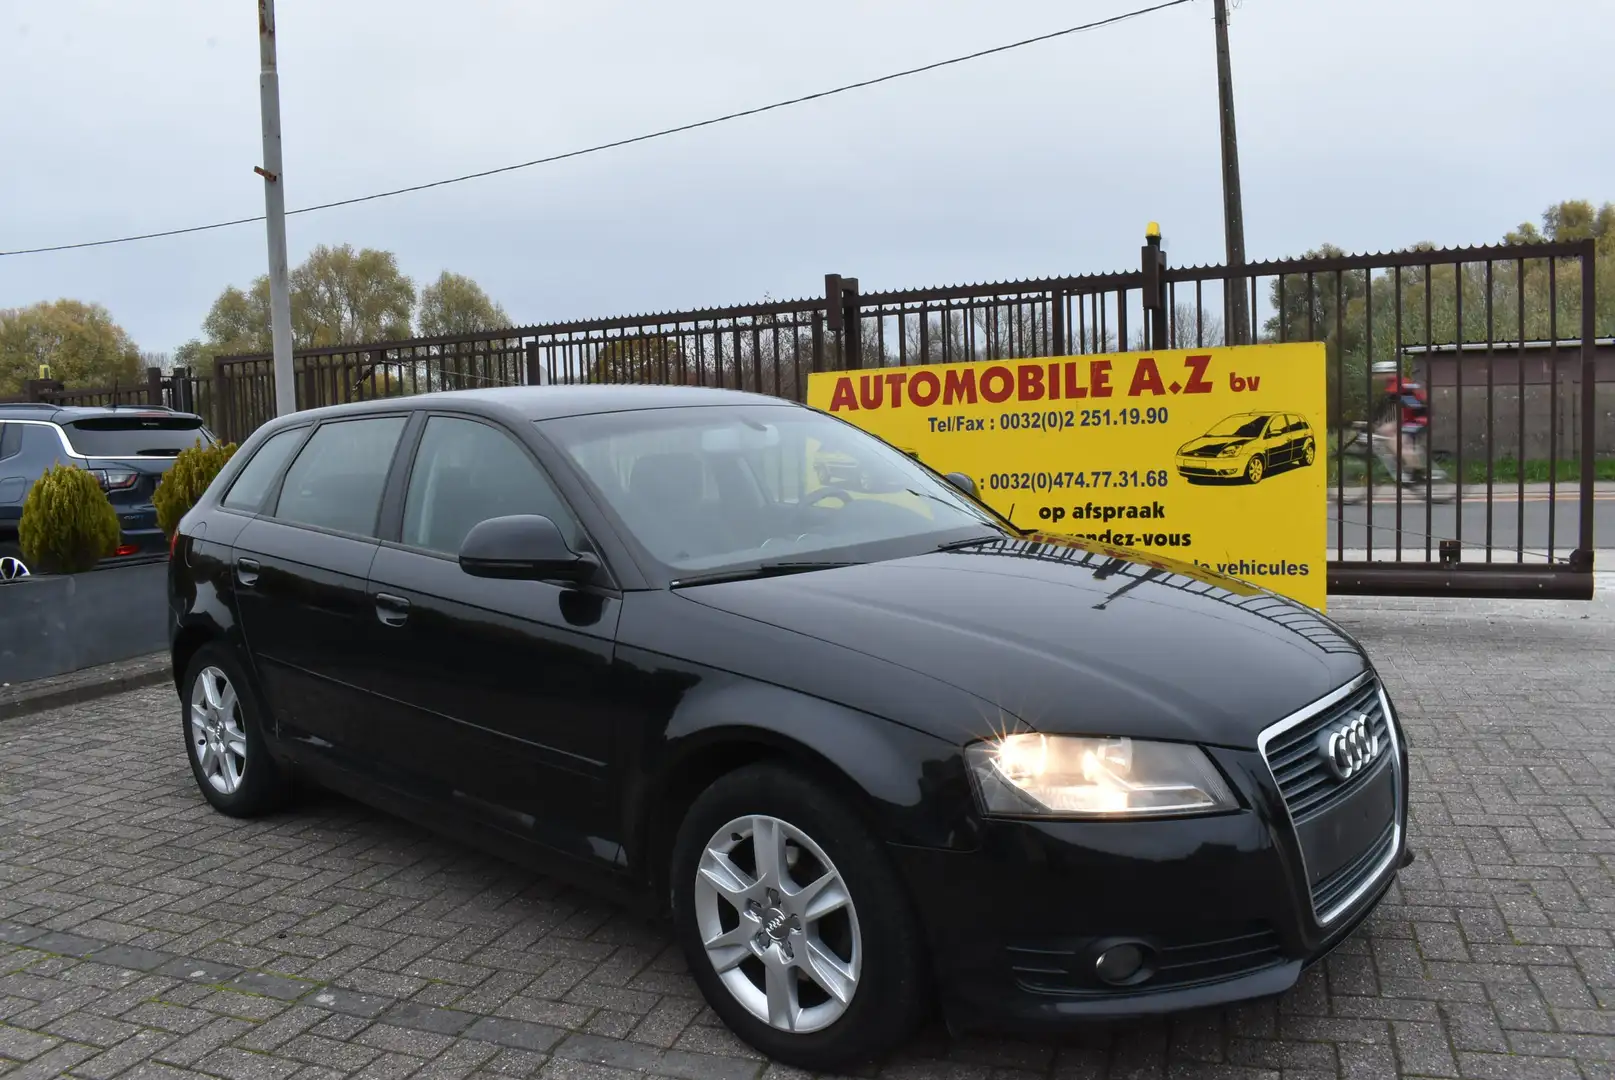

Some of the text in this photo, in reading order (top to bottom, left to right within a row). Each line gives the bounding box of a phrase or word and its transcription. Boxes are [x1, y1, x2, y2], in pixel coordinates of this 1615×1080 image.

[829, 355, 1260, 412] AUTOMOBILE A.Z bv
[928, 416, 985, 433] Tel/Fax
[1000, 411, 1075, 433] 0032(0)2
[1080, 407, 1168, 427] 251.19.90
[989, 470, 1169, 494] 0032(0)474.77.31.68
[1039, 501, 1166, 524] op afspraak
[1066, 528, 1192, 548] ndez-vous
[1216, 559, 1310, 577] vehicules
